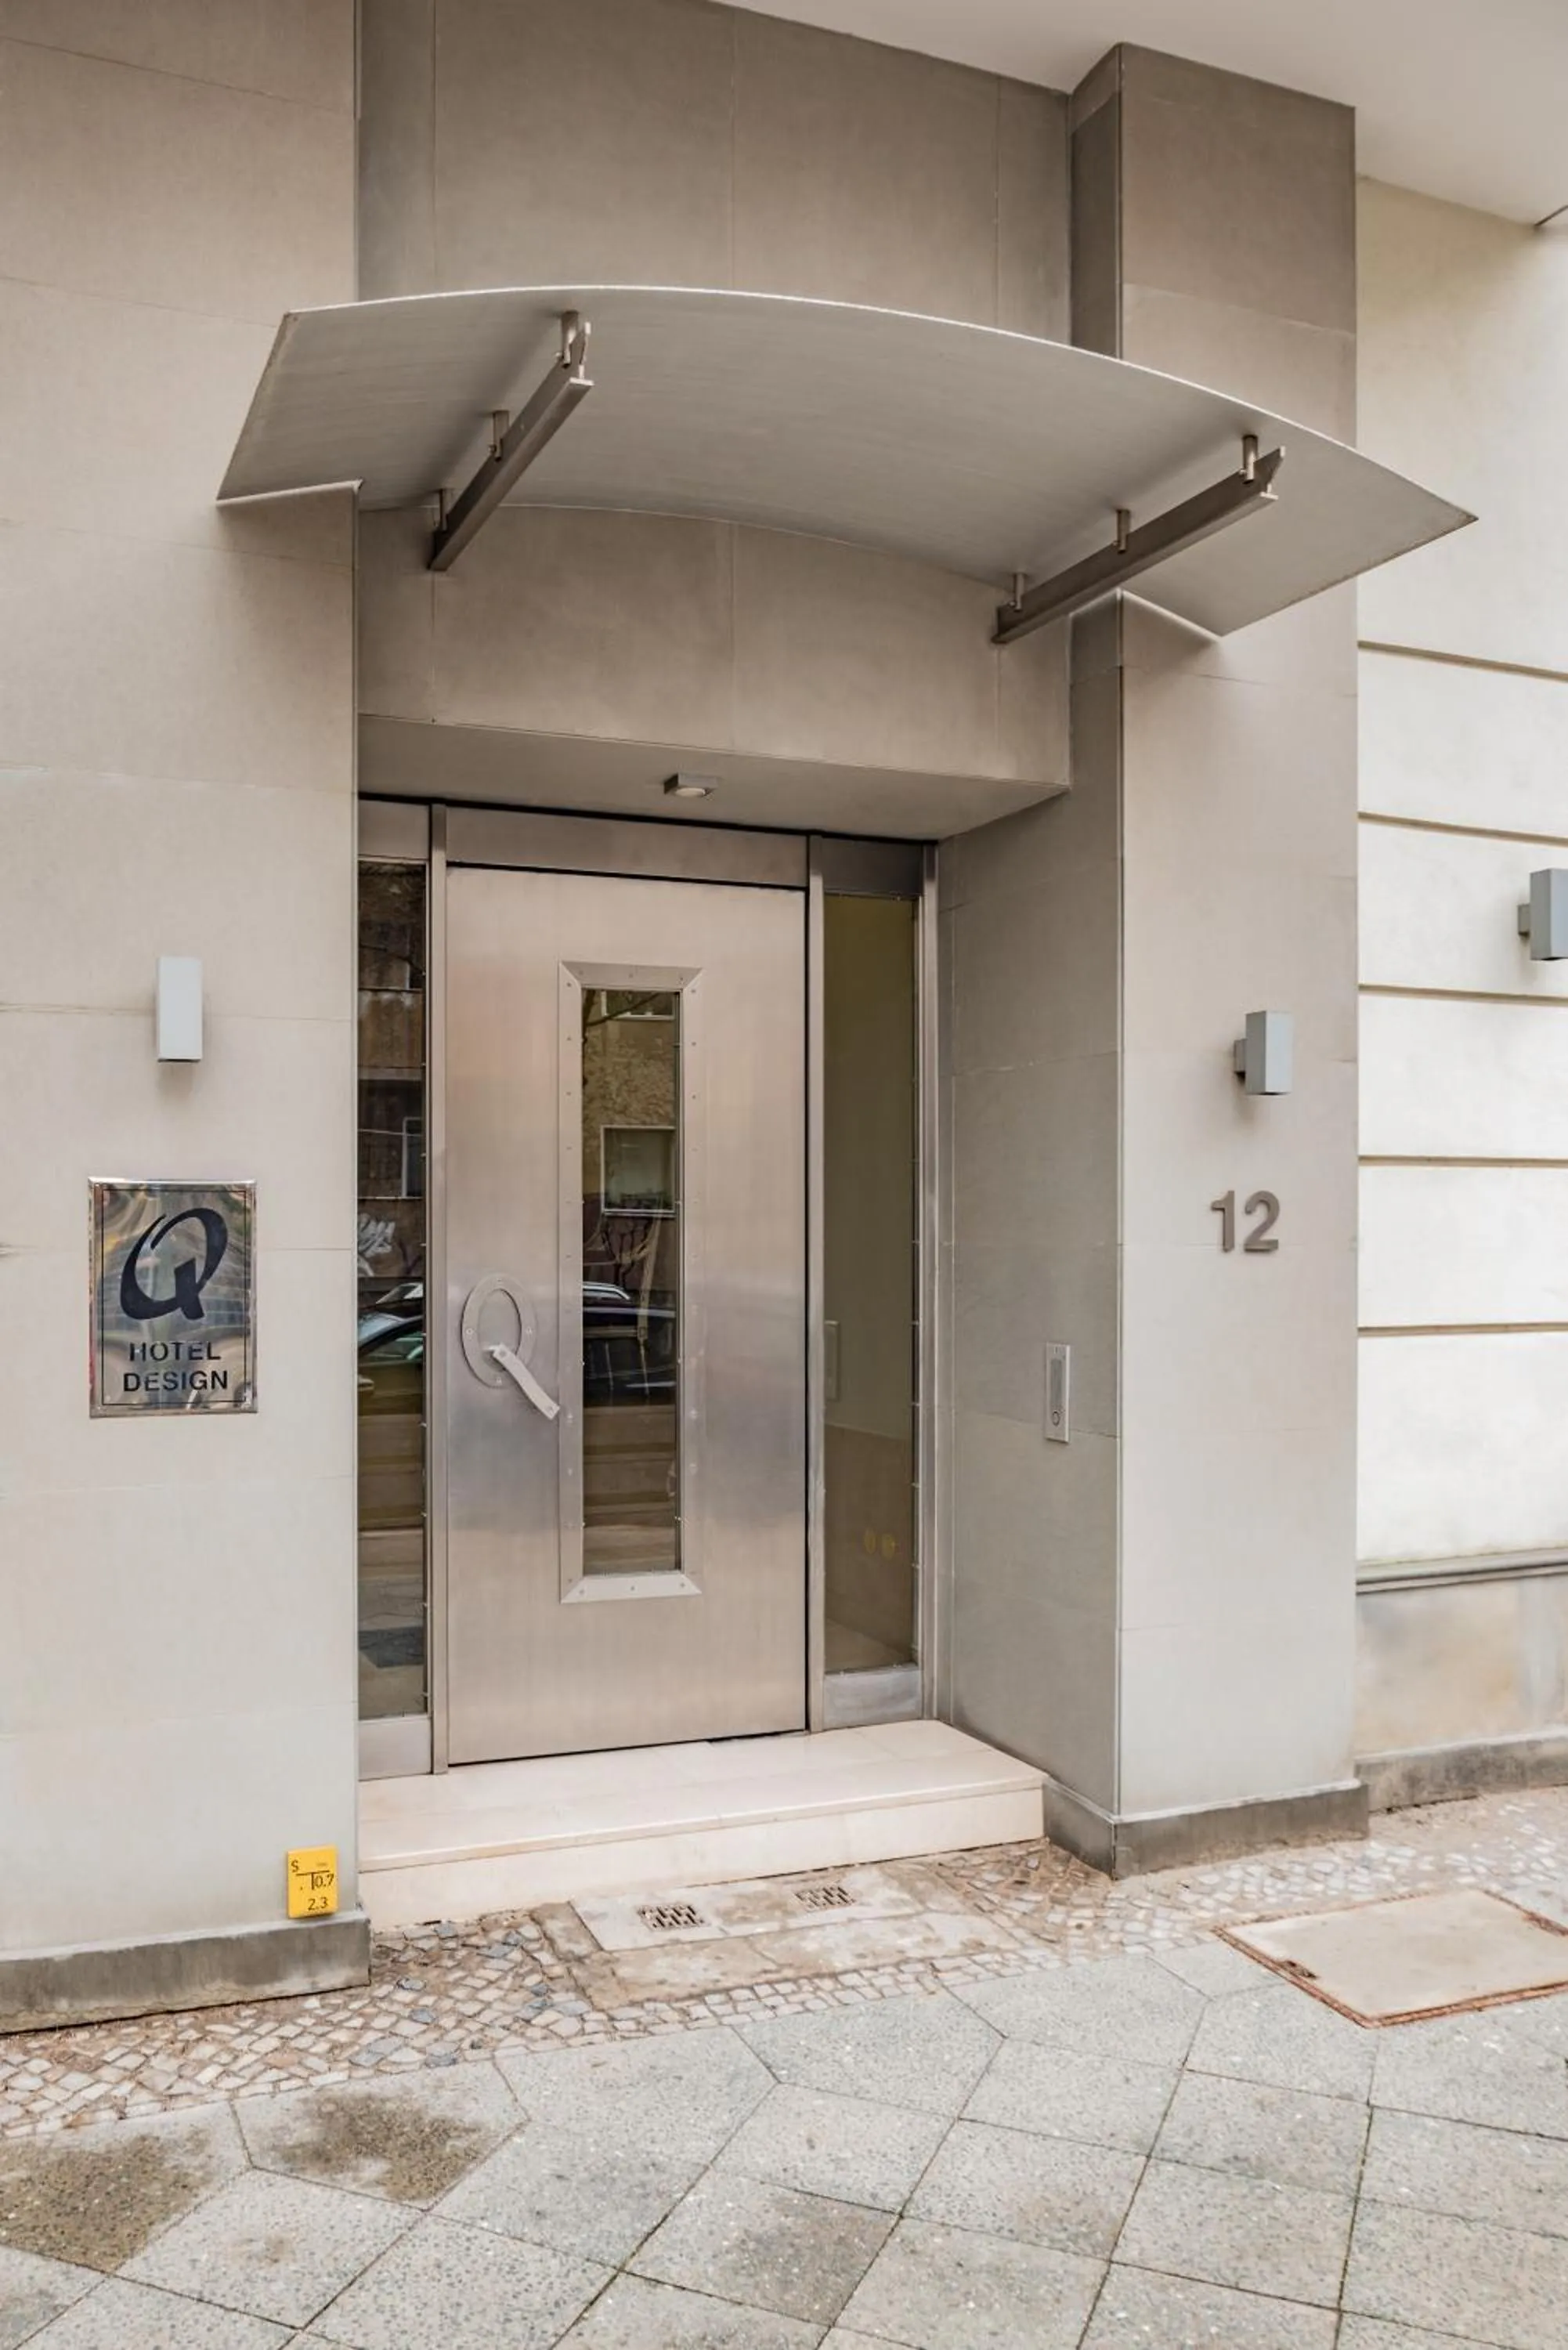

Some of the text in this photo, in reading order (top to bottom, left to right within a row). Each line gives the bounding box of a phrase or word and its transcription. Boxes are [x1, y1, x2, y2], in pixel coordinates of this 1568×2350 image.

[1210, 1190, 1281, 1253] 12
[120, 1208, 228, 1320] Q
[128, 1342, 222, 1362] HOTEL
[123, 1371, 228, 1392] DESIGN
[291, 1859, 299, 1873] S
[307, 1896, 328, 1911] 2.3
